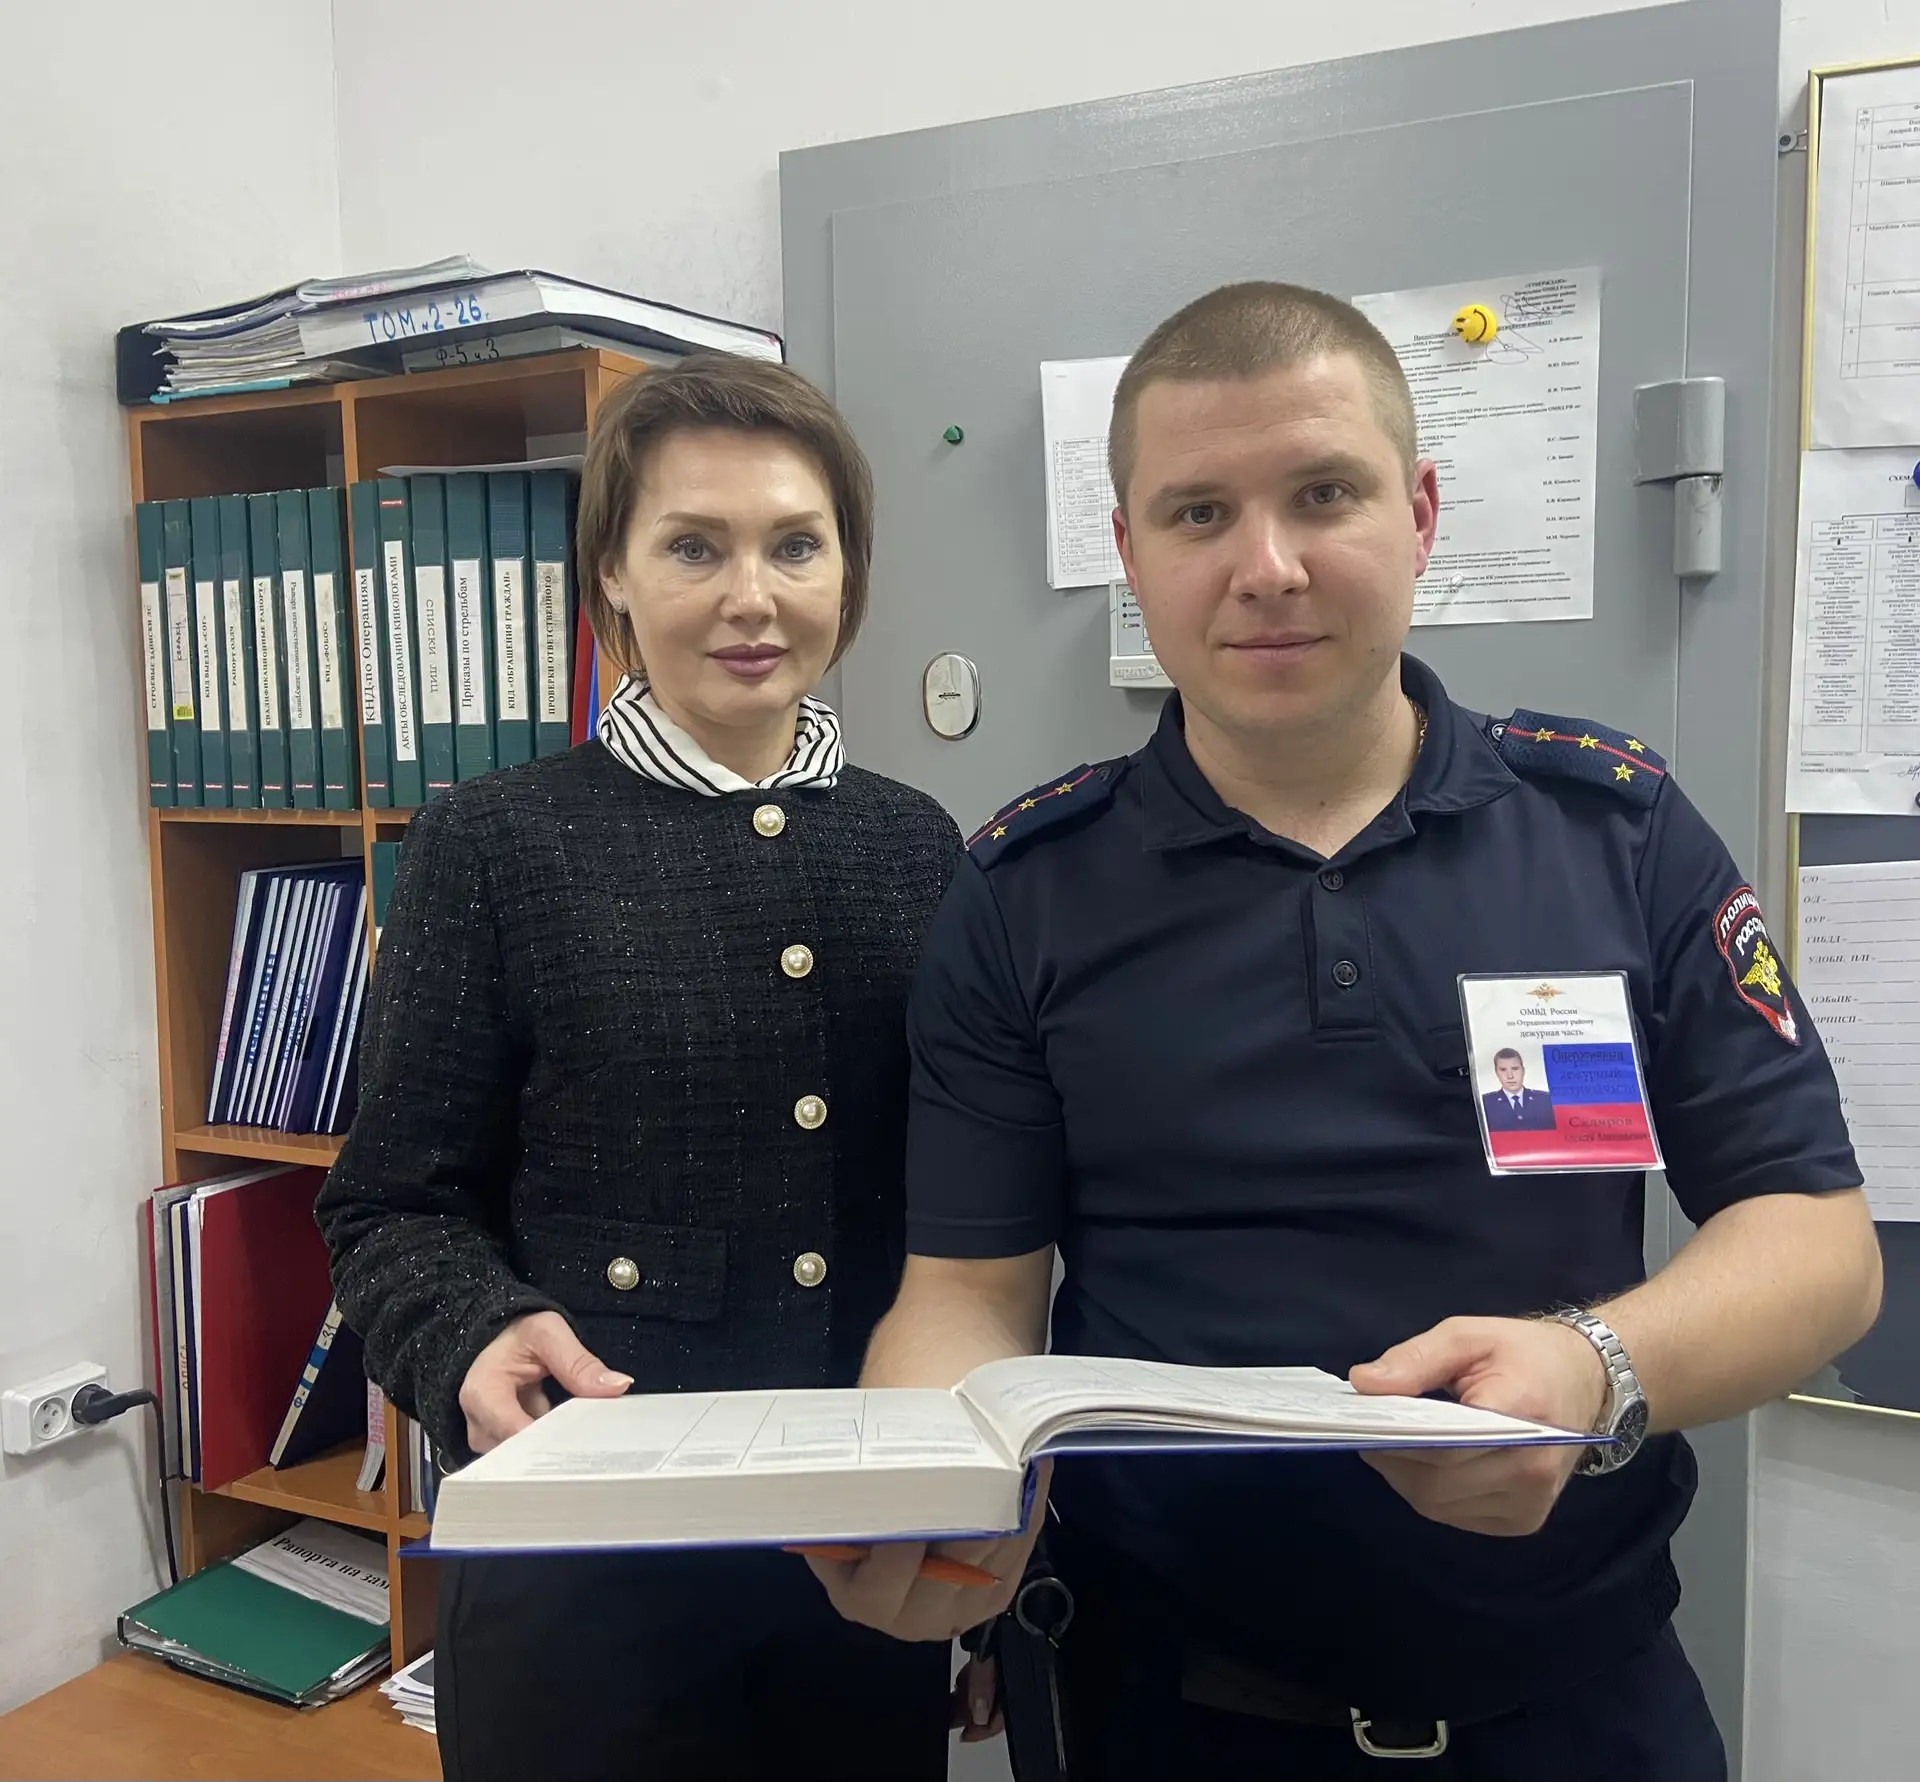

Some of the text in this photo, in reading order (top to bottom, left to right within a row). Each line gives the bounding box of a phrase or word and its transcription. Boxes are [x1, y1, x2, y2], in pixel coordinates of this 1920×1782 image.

[363, 310, 416, 343] ТОМ
[360, 574, 373, 659] Операциям
[389, 556, 410, 750] АКТЫ ОБСЛЕДОВАНИЙ КИНОЛОГАМИ
[426, 598, 438, 693] СПИСКИ ЛИЦ
[458, 577, 474, 708] Приказы по стрельбам
[545, 575, 556, 714] ПРОВЕРКИ ОТВЕТСТВЕННОГО
[508, 689, 516, 709] КНД
[1804, 916, 1826, 924] ОУР
[1806, 936, 1841, 944] ГИБДД
[1520, 1008, 1578, 1016] ОМВД России
[1520, 1030, 1560, 1039] дежурная
[273, 1536, 338, 1569] Рапорта
[338, 1563, 361, 1578] на
